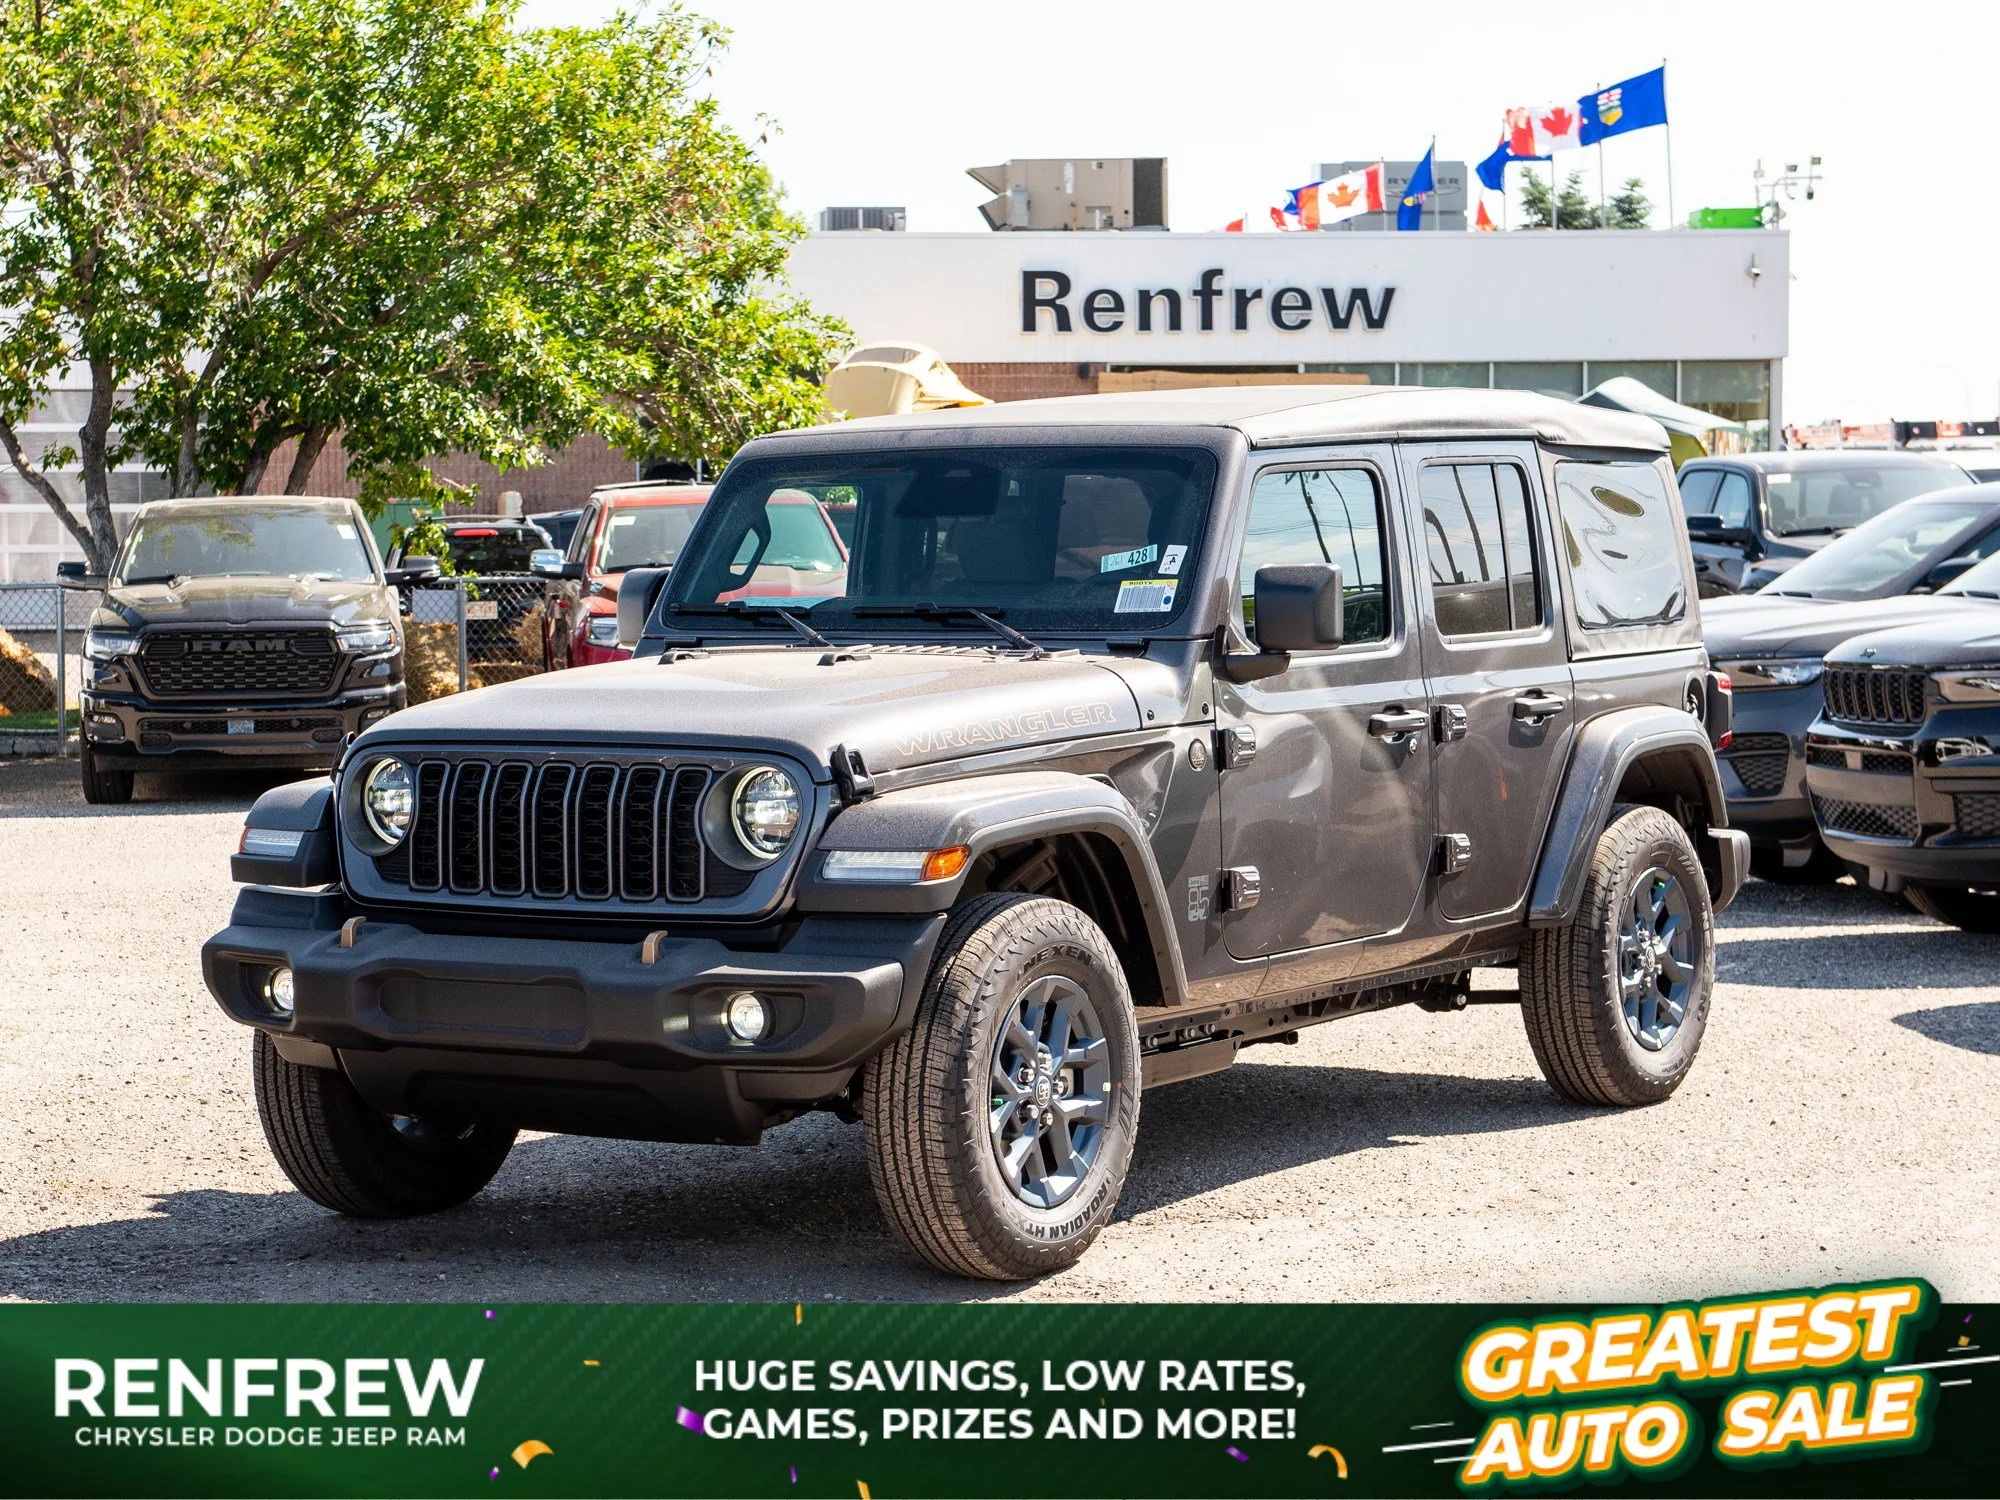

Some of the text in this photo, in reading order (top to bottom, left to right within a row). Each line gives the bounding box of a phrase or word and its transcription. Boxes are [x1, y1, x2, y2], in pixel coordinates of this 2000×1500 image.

[1022, 268, 1397, 333] Renfrew
[1128, 548, 1148, 566] 428
[193, 639, 286, 652] RAM
[890, 702, 1116, 755] WRANGLER
[1023, 943, 1093, 975] NEXEN
[1050, 1181, 1109, 1239] ROADIAN
